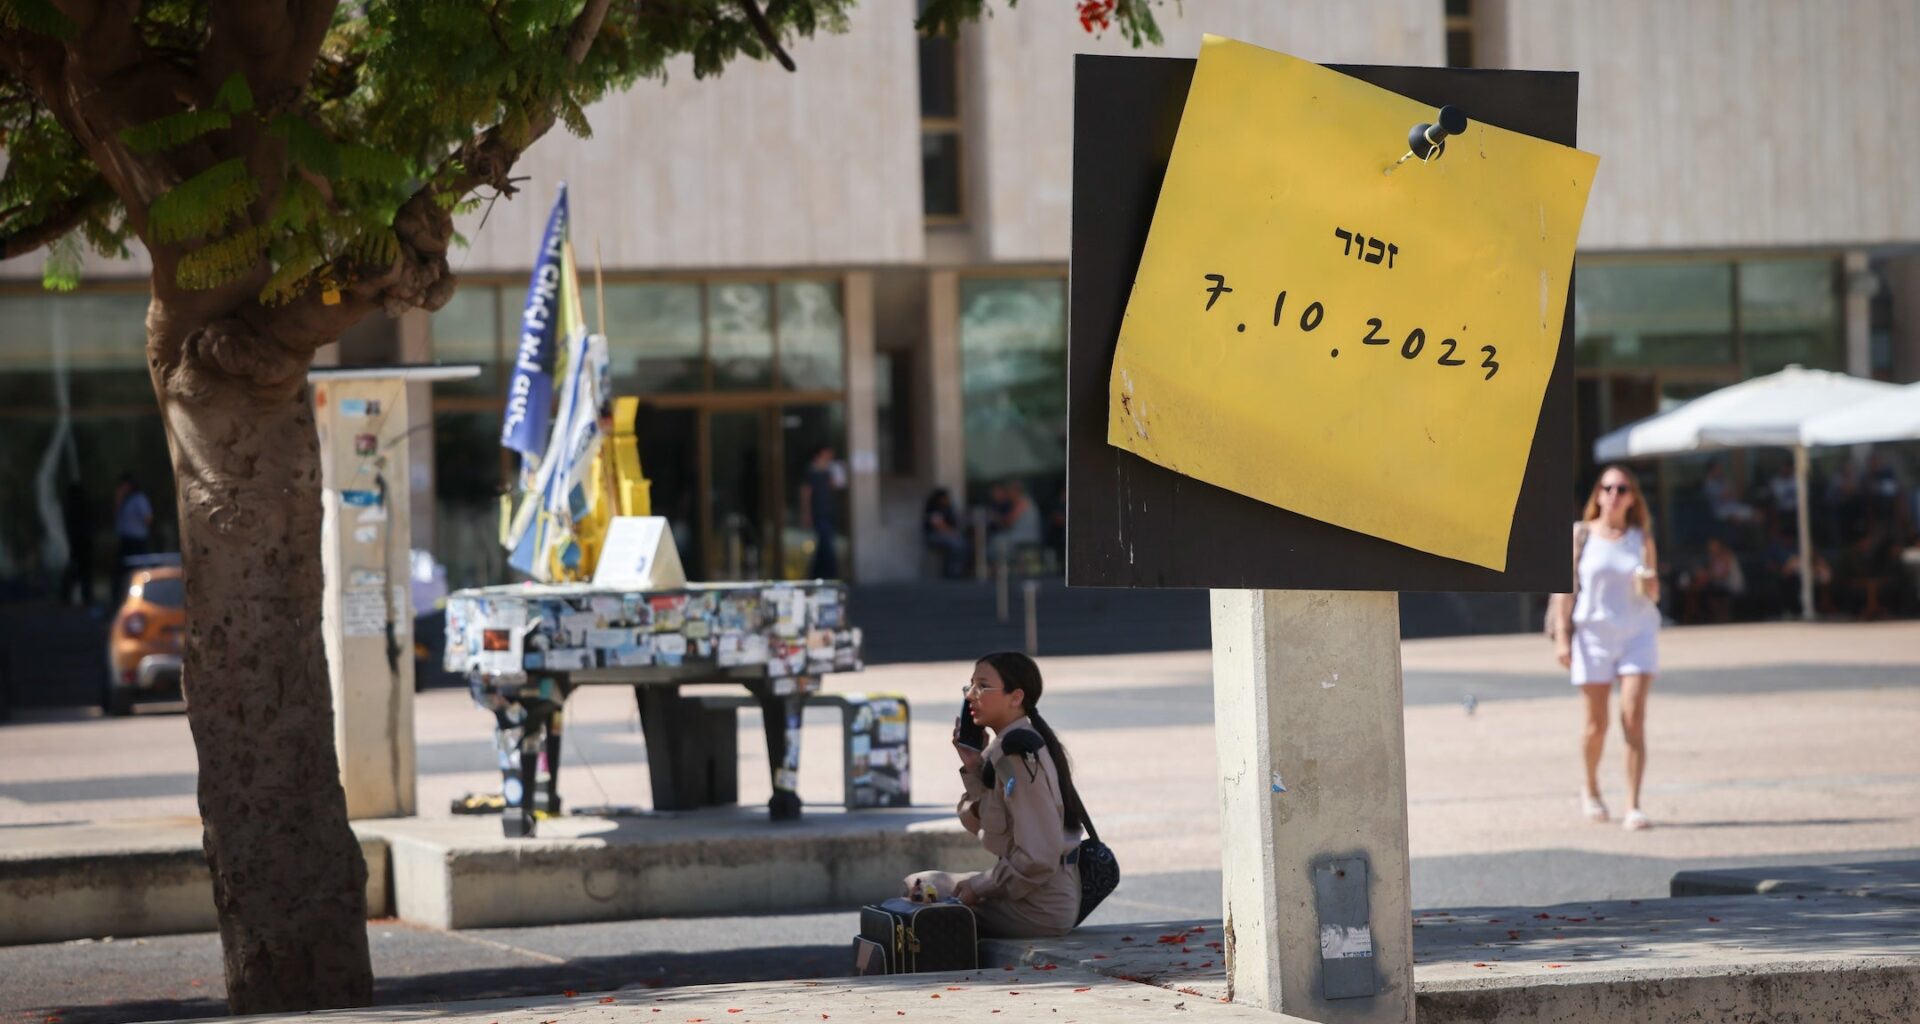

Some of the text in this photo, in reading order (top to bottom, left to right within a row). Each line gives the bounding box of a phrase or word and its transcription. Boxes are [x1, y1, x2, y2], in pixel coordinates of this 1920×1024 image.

[1335, 226, 1399, 269] זכור
[1204, 273, 1499, 381] 7.10.2023
[518, 332, 542, 373] אין
